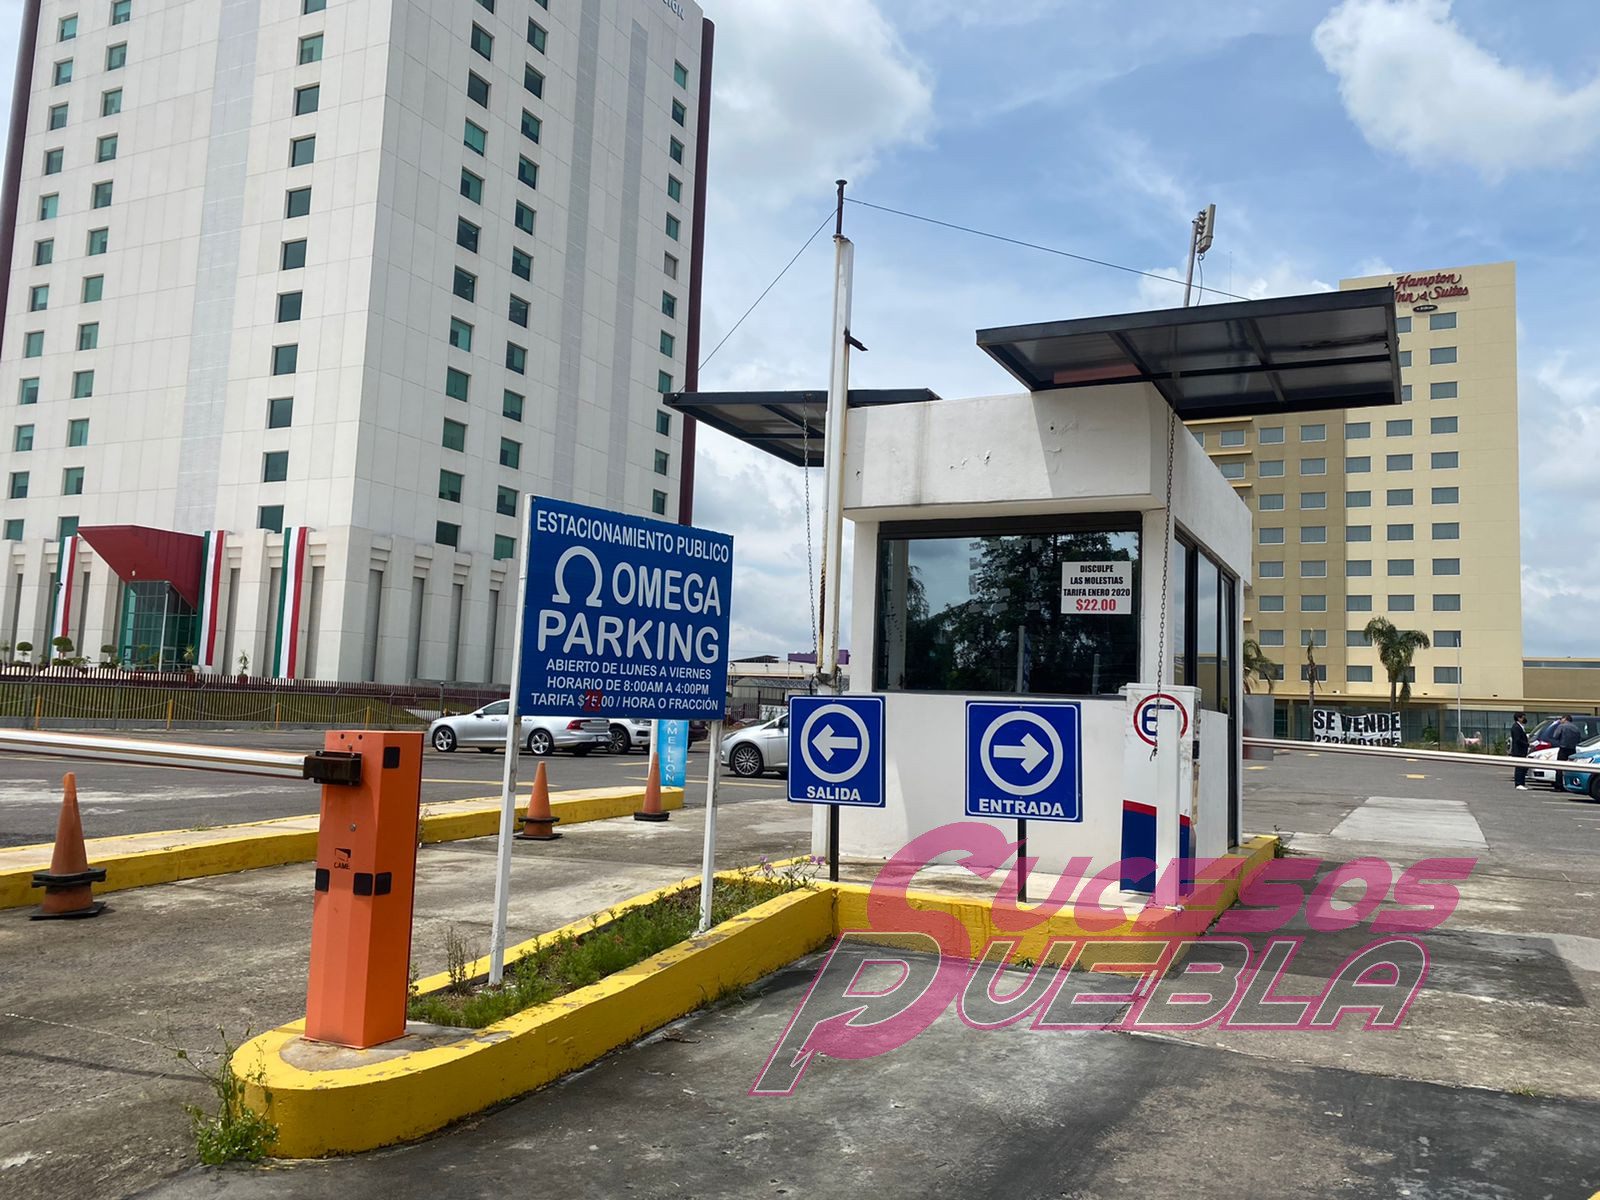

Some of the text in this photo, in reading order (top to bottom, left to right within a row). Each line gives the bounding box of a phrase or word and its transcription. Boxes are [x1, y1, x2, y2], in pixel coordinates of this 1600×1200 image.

[1395, 273, 1462, 291] Hampton
[1395, 291, 1419, 303] Inn
[1429, 285, 1469, 300] Suites
[537, 510, 729, 563] ESTACIONAMIENTO PUBLICO
[1080, 565, 1114, 573] DISCULPE
[612, 561, 721, 617] OMEGA
[1070, 576, 1124, 585] LAS MOLESTIAS
[1063, 588, 1130, 597] TARIFA ENERO 2020
[1076, 598, 1116, 612] $22.00
[537, 609, 719, 664] PARKING
[546, 658, 712, 680] ABIERTO DE LUNES A VIERNES
[547, 676, 709, 695] HORARIO DE 8:00AM A 4:00PM
[531, 692, 575, 707] TARIFA
[622, 696, 656, 709] HORA
[658, 697, 667, 709] O
[668, 696, 718, 711] FRACCIÓN
[1314, 711, 1400, 732] SE VENDE
[806, 785, 862, 801] SALIDA
[978, 798, 1065, 816] ENTRADA
